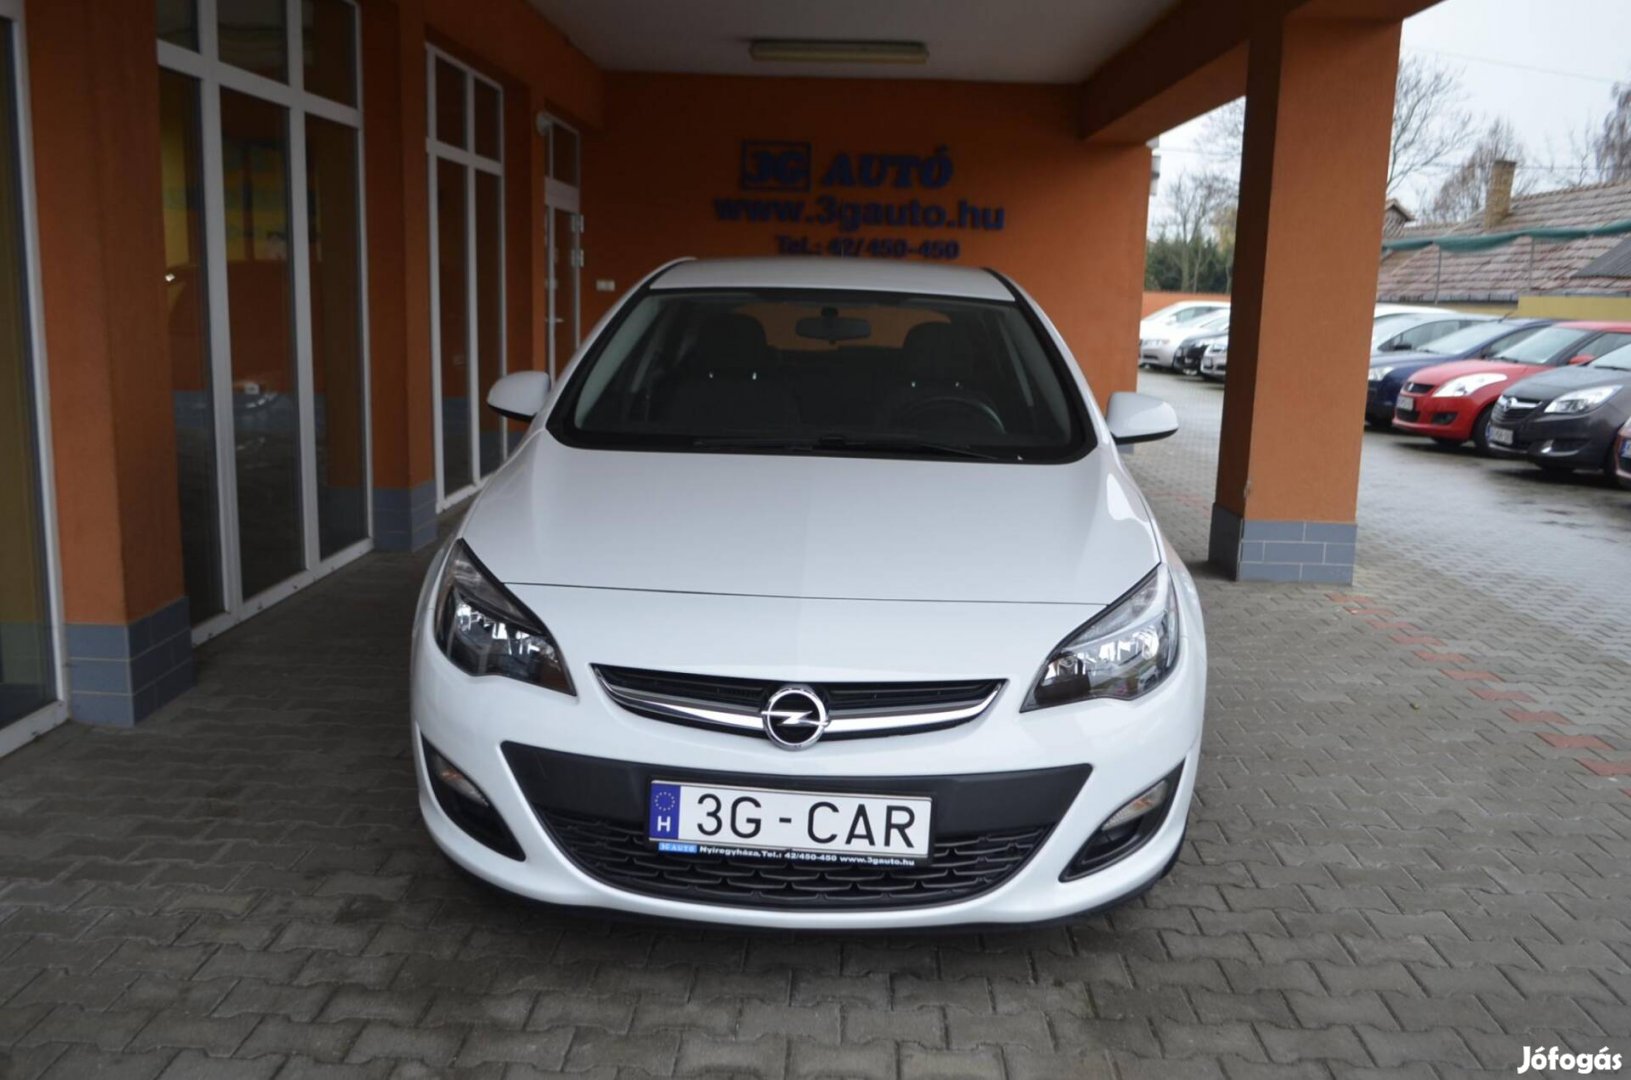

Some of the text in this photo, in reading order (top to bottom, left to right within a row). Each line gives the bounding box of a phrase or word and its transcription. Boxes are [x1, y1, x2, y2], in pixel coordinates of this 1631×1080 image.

[748, 144, 953, 189] 3G AUTÓ
[713, 194, 1005, 232] www.3gauto.hu
[656, 815, 671, 833] H
[840, 856, 915, 867] www.3gauto.hu
